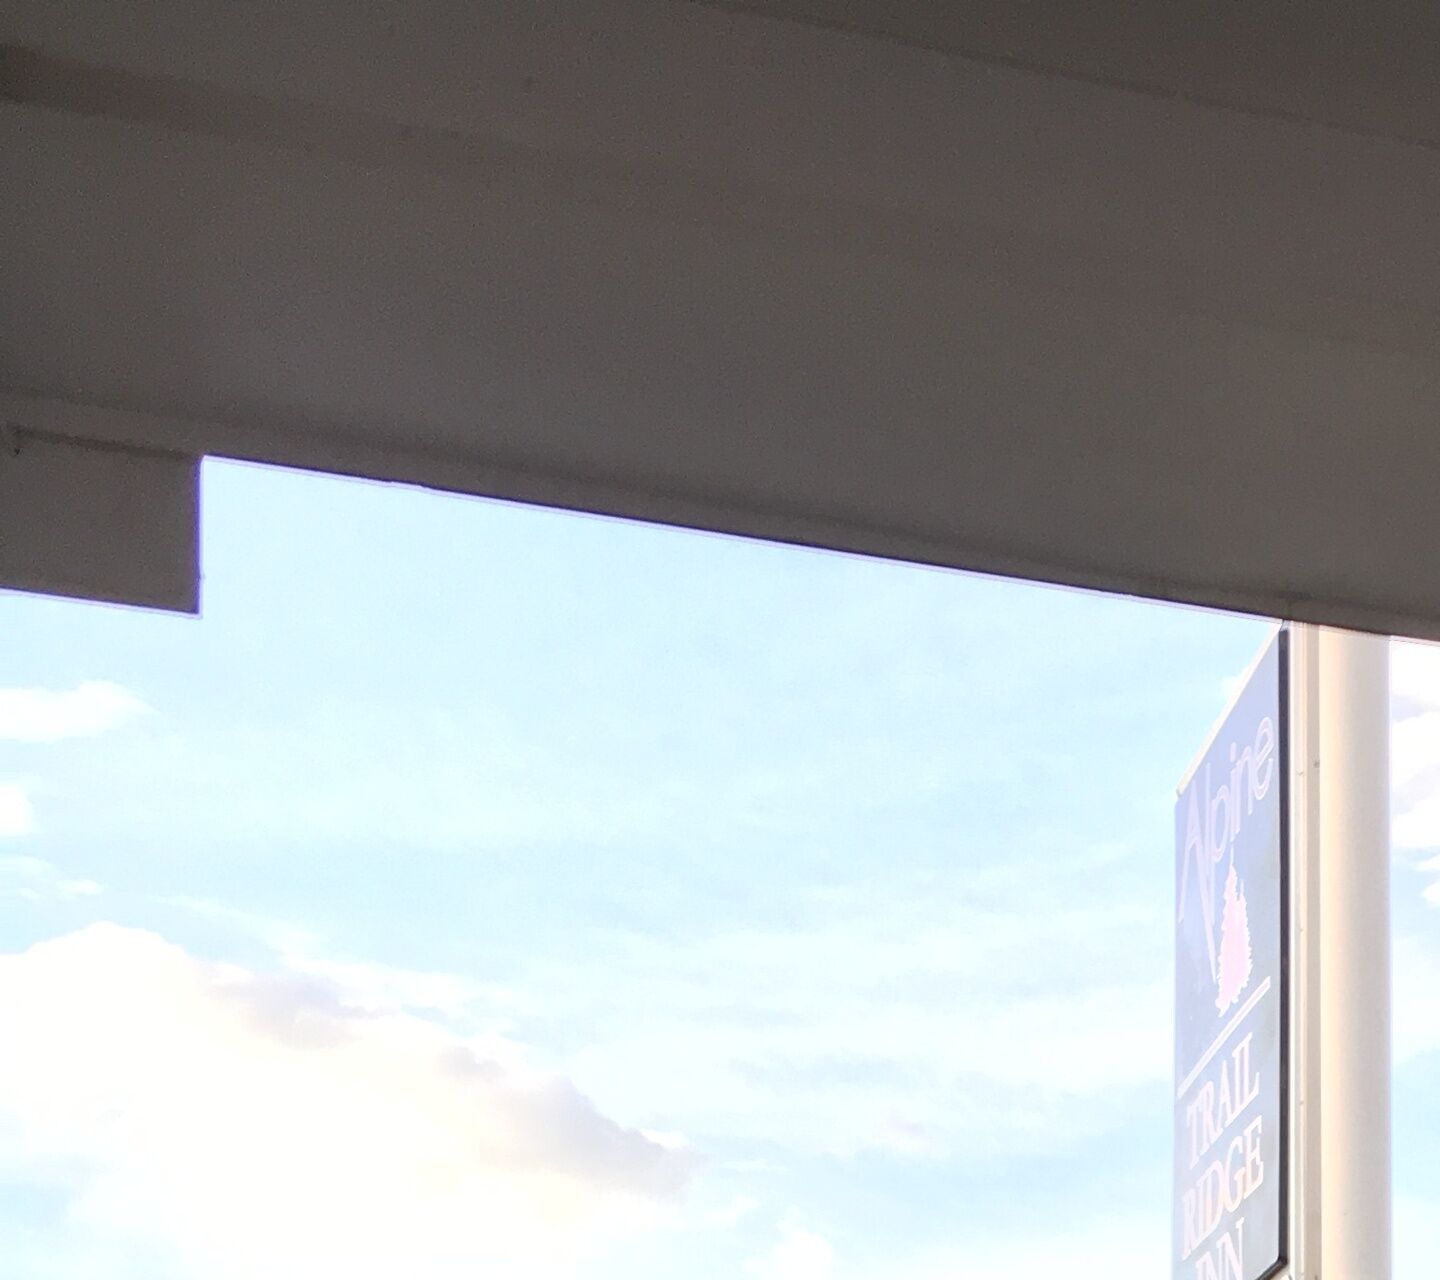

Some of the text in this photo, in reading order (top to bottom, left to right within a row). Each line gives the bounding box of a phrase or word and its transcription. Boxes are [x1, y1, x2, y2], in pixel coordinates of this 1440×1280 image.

[1179, 716, 1275, 984] Alpine
[1186, 1032, 1261, 1171] TRAIL
[1181, 1115, 1264, 1262] RIDGE
